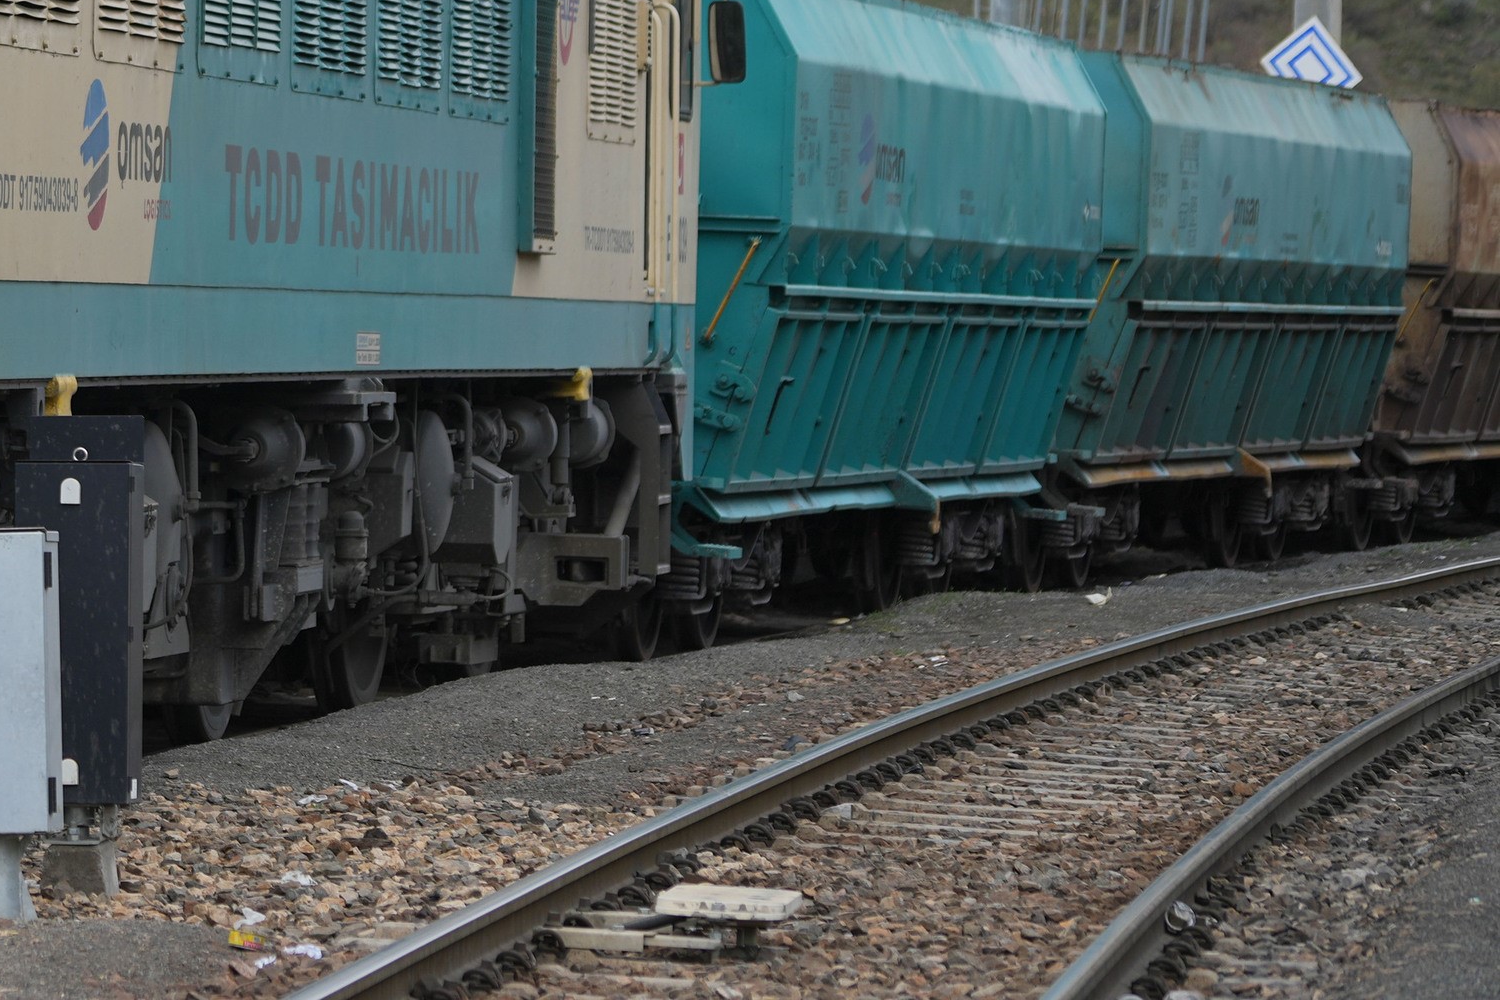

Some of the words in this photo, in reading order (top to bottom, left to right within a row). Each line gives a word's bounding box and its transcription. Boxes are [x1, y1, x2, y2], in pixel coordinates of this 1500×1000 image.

[117, 121, 172, 183] omsan
[19, 175, 79, 212] 91759043039-8
[225, 144, 302, 245] TCDD
